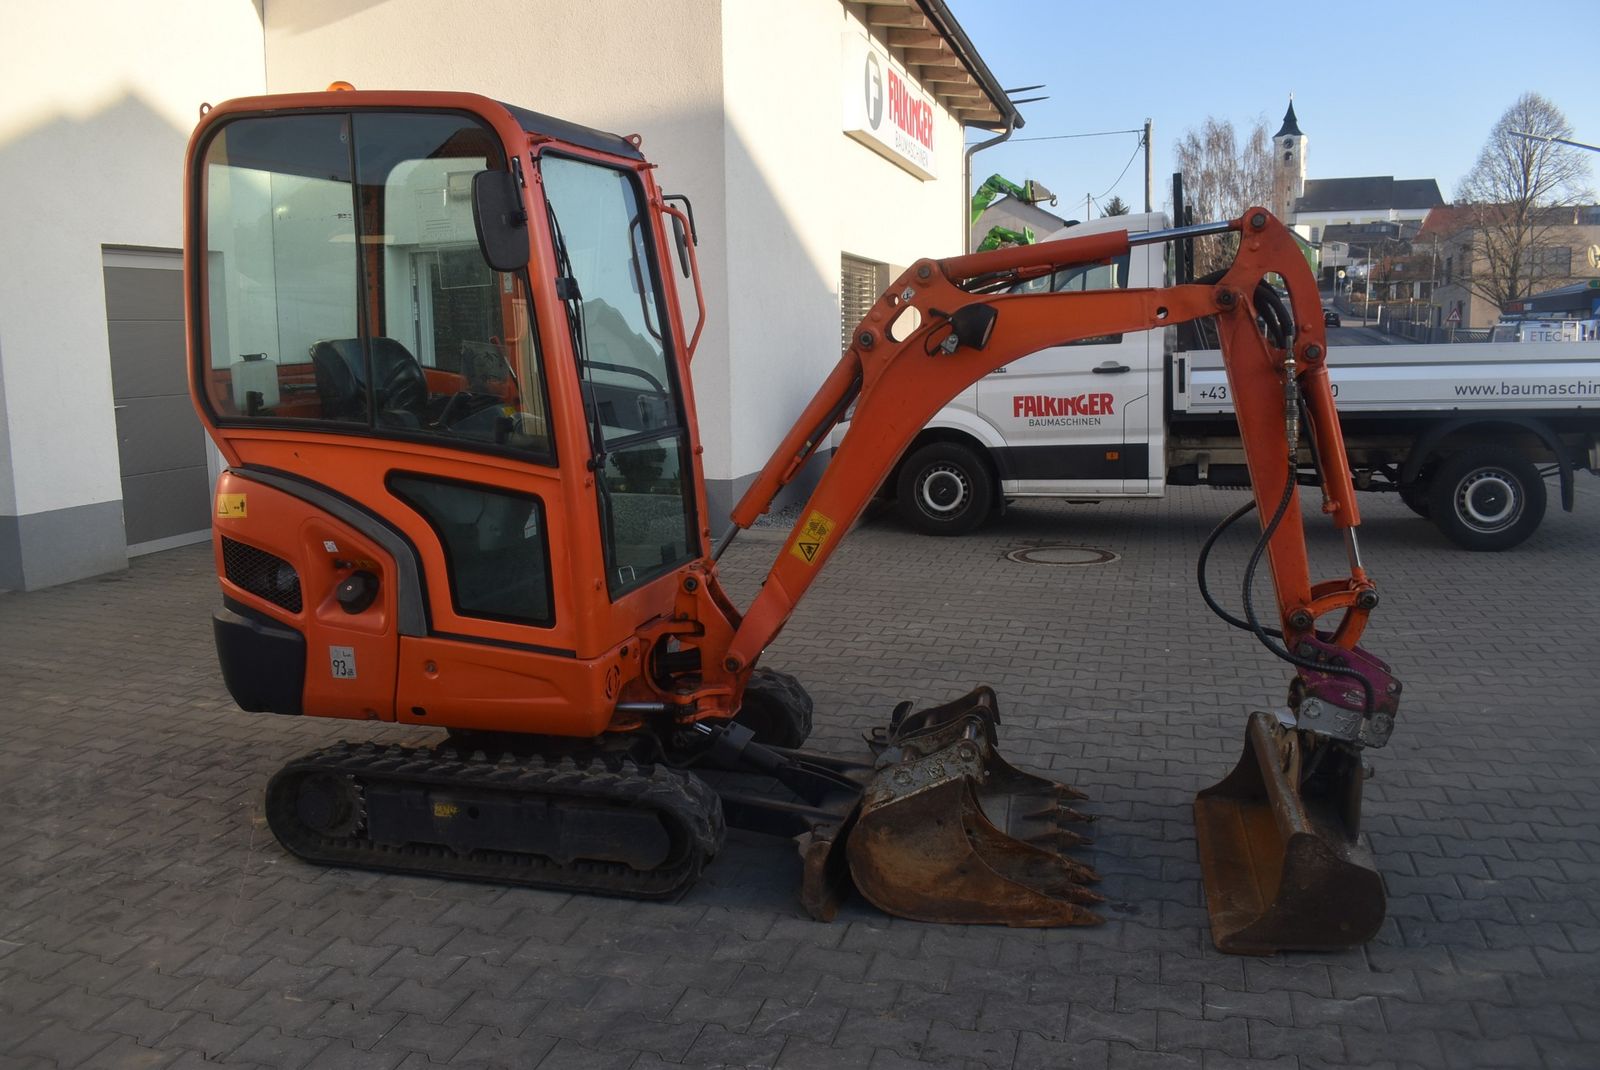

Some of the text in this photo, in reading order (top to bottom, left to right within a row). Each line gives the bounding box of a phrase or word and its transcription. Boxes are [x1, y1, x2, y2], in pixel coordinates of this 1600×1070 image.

[888, 67, 933, 152] FALKINGER
[1200, 386, 1227, 400] +43
[1013, 393, 1114, 417] FALKINGER
[1028, 417, 1101, 427] BAUMASCHINEN
[333, 659, 347, 675] 93
